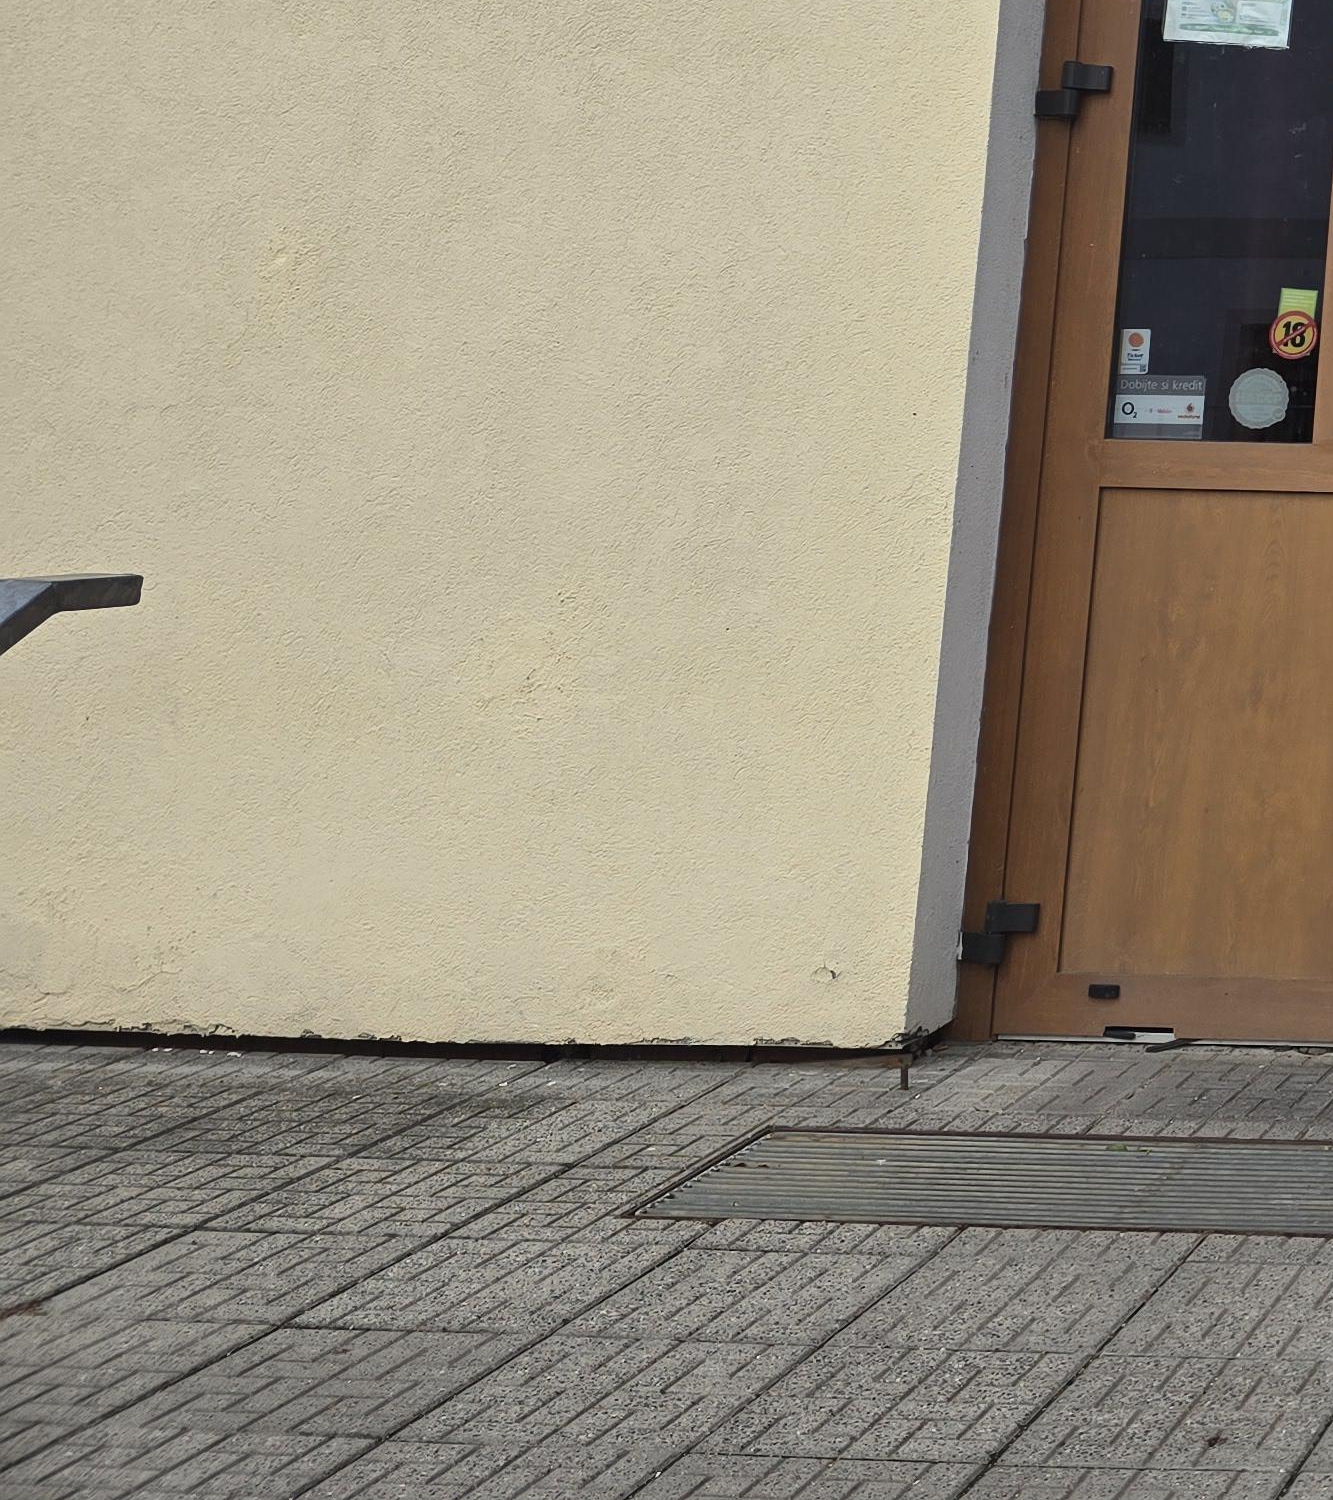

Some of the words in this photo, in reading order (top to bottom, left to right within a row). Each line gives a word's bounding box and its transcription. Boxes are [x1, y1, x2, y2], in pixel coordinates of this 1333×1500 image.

[1281, 320, 1307, 349] 18
[1120, 379, 1158, 392] Dobijte
[1161, 379, 1170, 391] si
[1172, 379, 1204, 392] kredit
